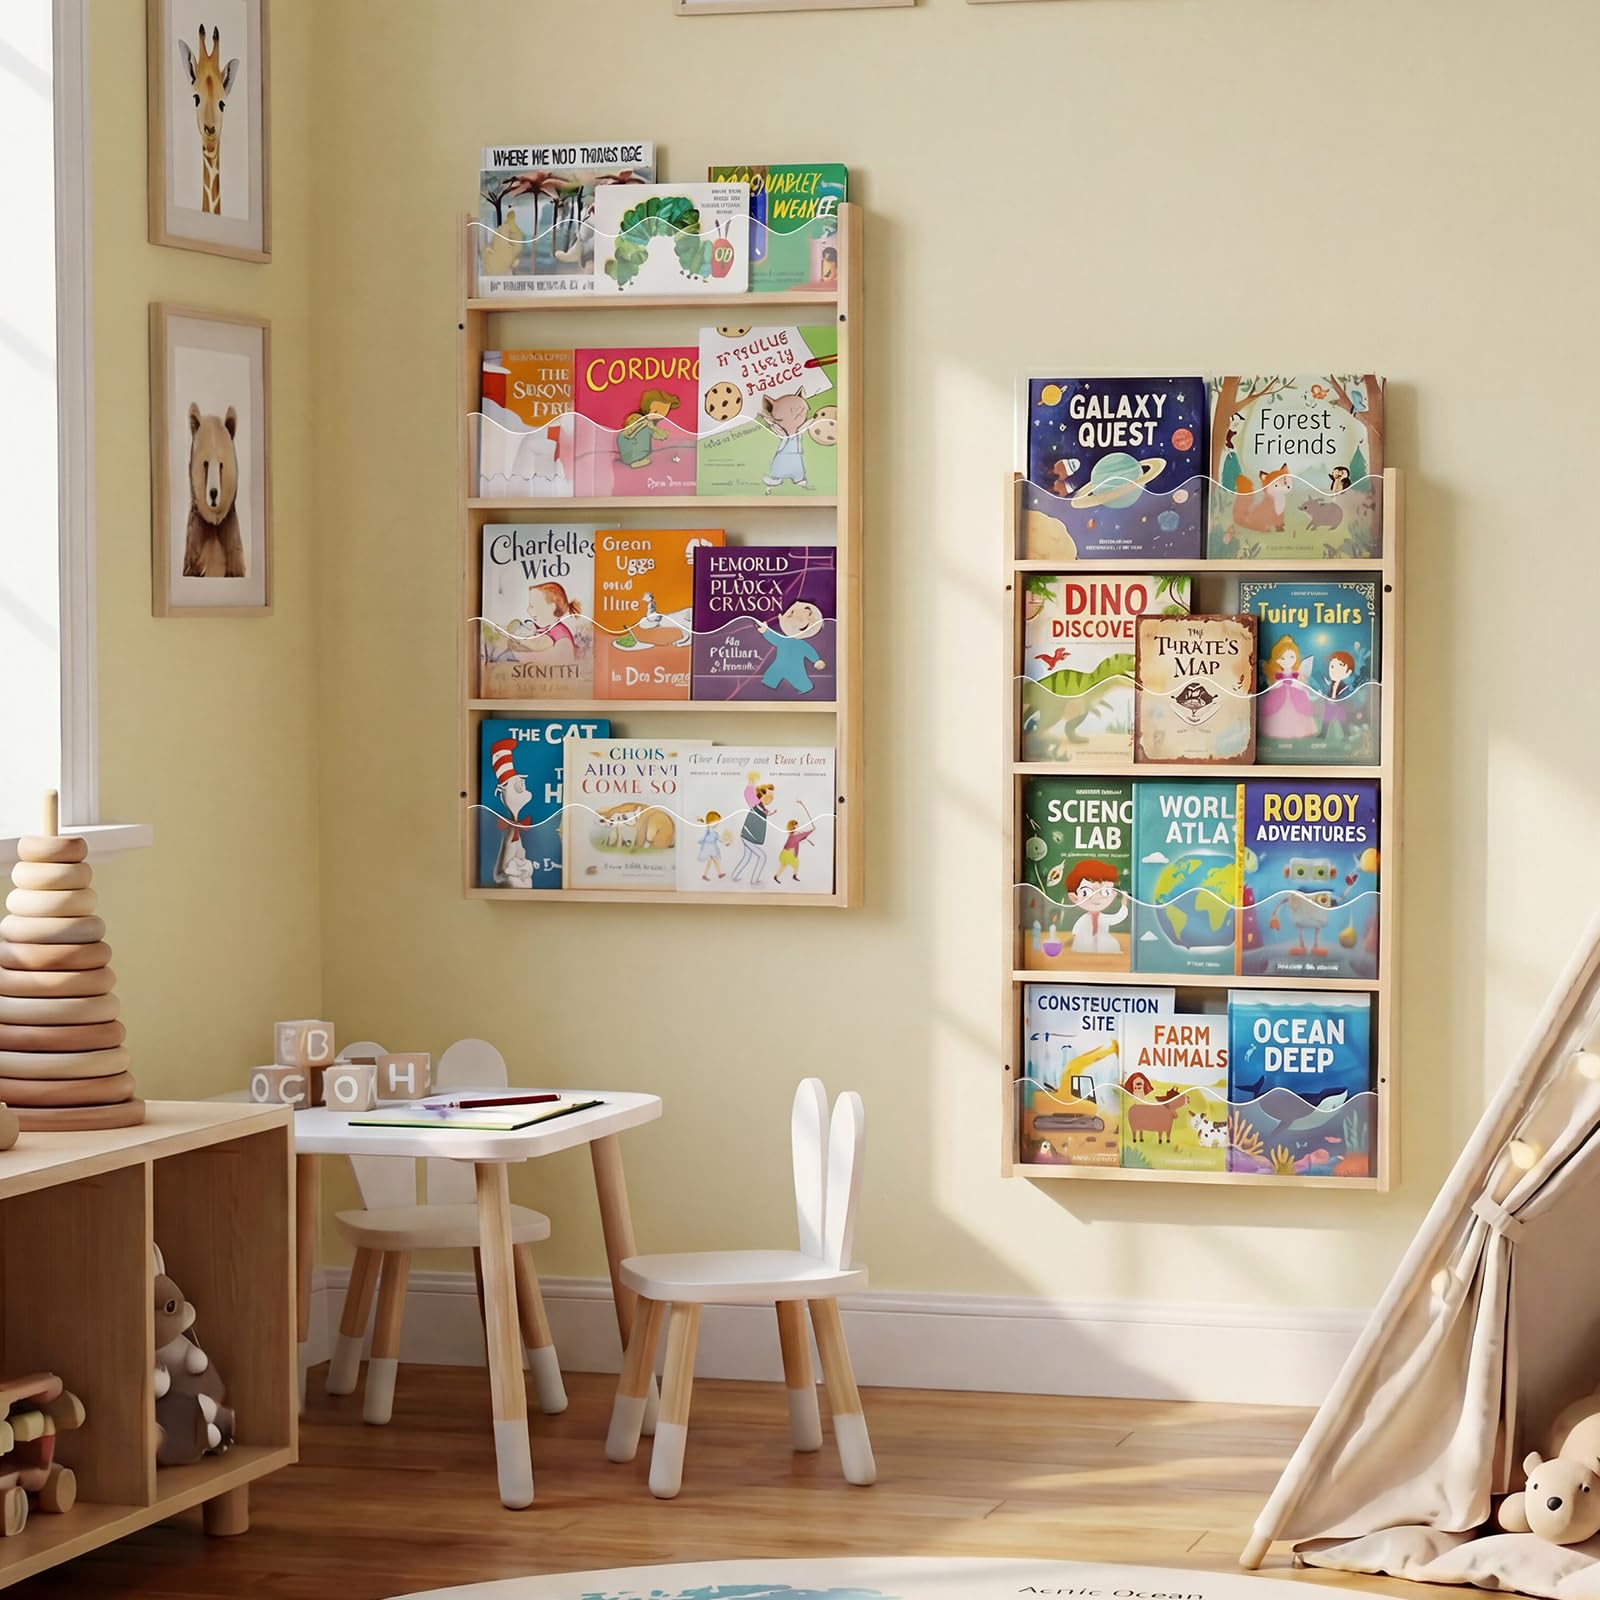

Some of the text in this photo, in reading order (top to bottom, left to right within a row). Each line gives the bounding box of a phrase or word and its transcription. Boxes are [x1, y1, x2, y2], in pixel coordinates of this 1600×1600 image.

[537, 368, 569, 381] THE
[1069, 393, 1168, 420] GALAXY
[1261, 408, 1331, 430] Forest
[1078, 421, 1158, 449] QUEST
[1254, 432, 1337, 455] Friends
[1065, 583, 1148, 616] DINO
[1052, 620, 1134, 638] DISCOVE
[1174, 657, 1220, 678] MAP
[508, 723, 598, 744] THE CAT
[1159, 795, 1235, 819] WORL
[1263, 793, 1360, 822] ROBOY
[1075, 826, 1122, 850] LAB
[1165, 821, 1236, 845] ATLA
[1256, 824, 1367, 843] ADVENTURES
[1082, 1015, 1115, 1031] SITE
[1253, 1018, 1345, 1045] OCEAN
[307, 1029, 329, 1062] B
[1154, 1025, 1210, 1046] FARM
[1137, 1047, 1228, 1068] ANIMALS
[1264, 1046, 1334, 1073] DEEP
[279, 1074, 306, 1104] C
[334, 1075, 359, 1104] O
[388, 1061, 415, 1094] H
[1113, 1588, 1204, 1600] Ocean
